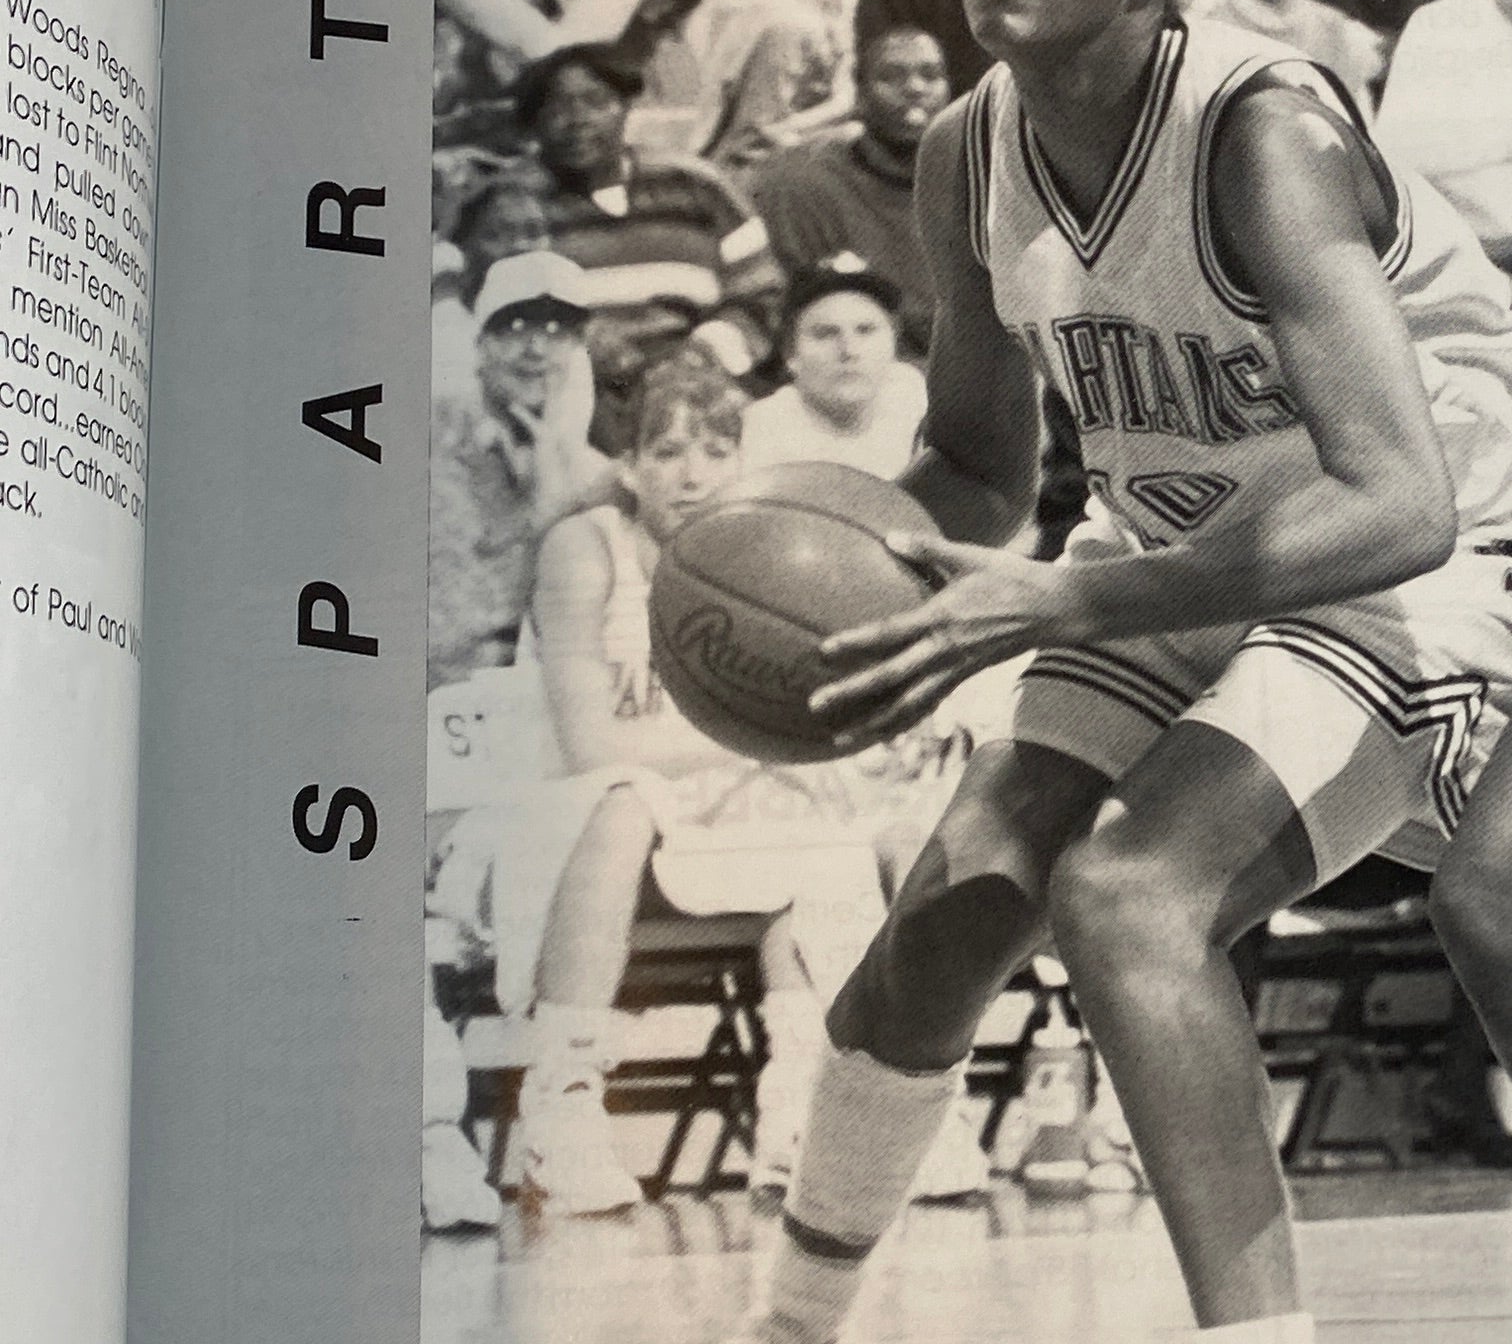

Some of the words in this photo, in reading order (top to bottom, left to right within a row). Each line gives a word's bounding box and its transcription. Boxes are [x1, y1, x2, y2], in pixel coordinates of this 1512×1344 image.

[8, 33, 86, 105] blocks
[89, 88, 120, 129] per
[7, 81, 51, 131] lost
[57, 107, 80, 146] to
[85, 123, 119, 175] Flint
[31, 188, 78, 241] Miss
[54, 160, 116, 219] pulled
[28, 235, 126, 321] First-Team
[12, 285, 103, 352] mention
[46, 350, 90, 392] and
[93, 367, 115, 407] 4.1
[20, 435, 128, 509] all-Catholic
[13, 583, 40, 616] of
[48, 587, 92, 634] Paul
[98, 614, 128, 650] and
